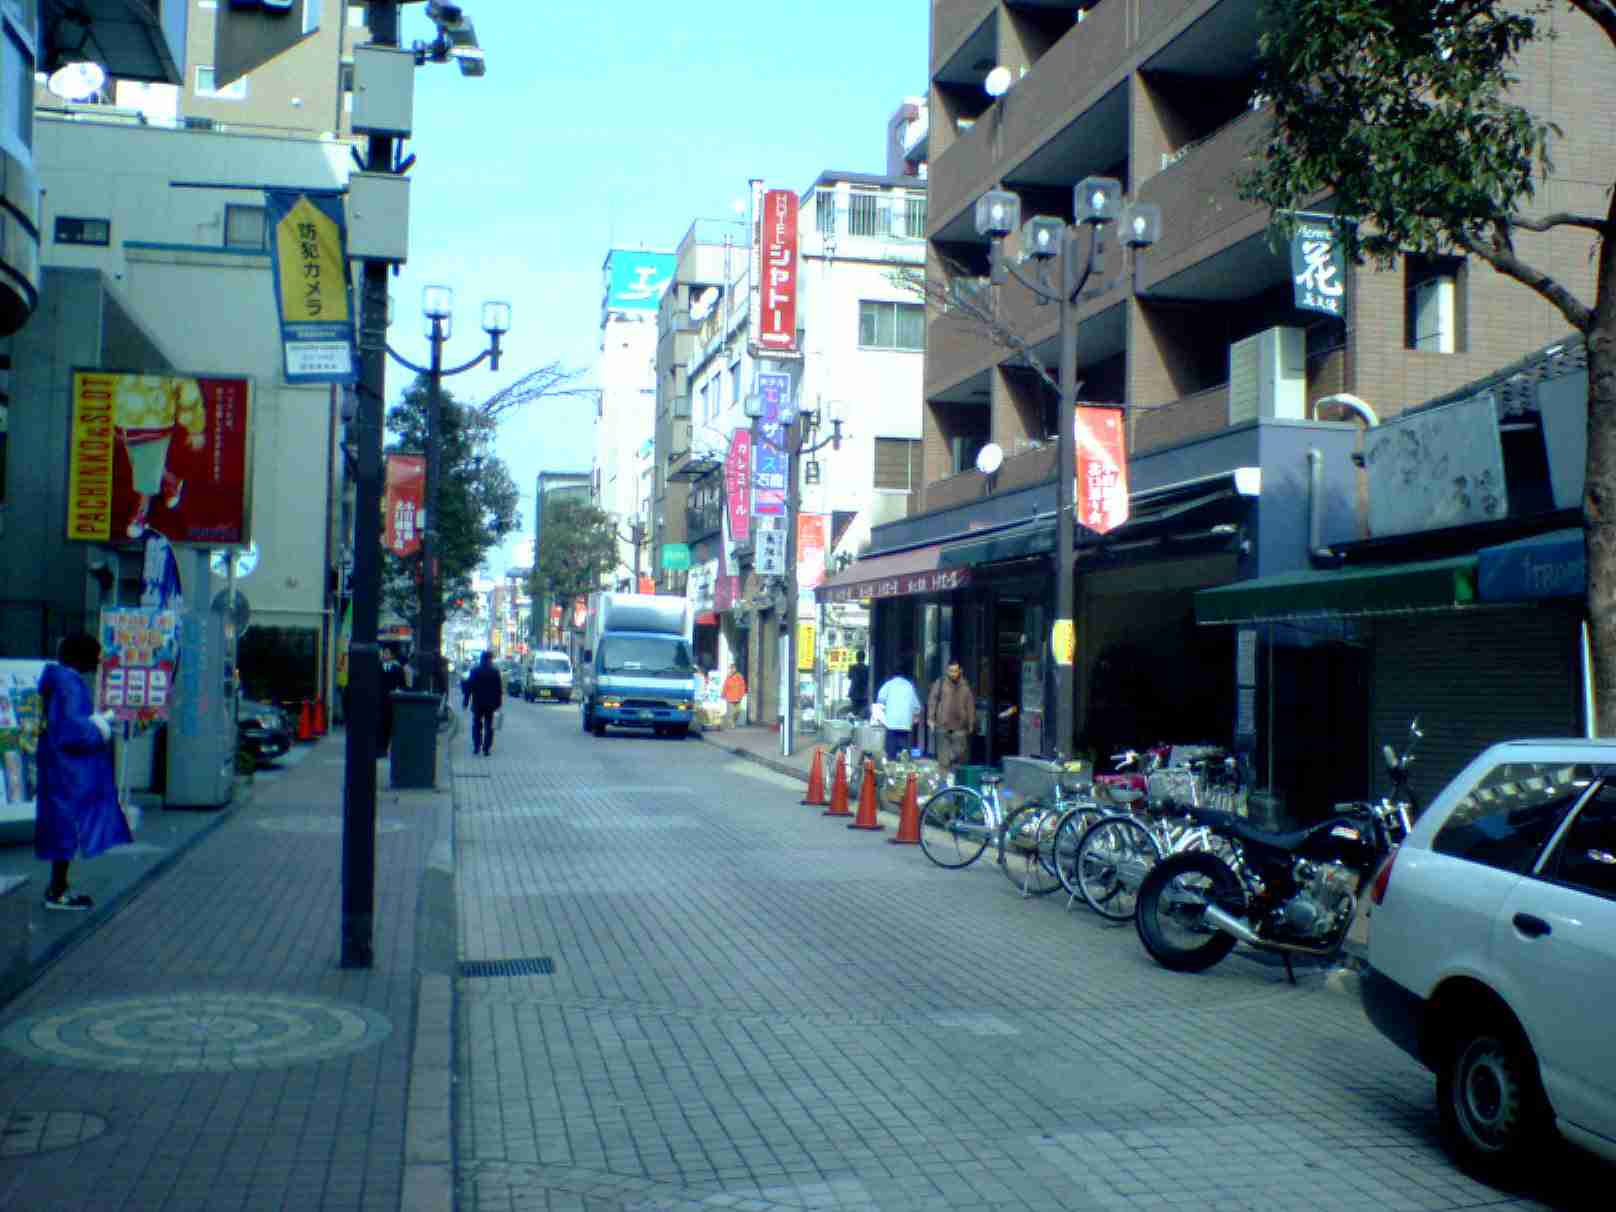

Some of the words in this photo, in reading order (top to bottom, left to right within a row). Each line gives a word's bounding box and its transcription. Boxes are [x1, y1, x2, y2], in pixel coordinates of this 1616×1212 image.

[296, 223, 324, 318] 防犯カメラ
[1296, 240, 1343, 296] 花
